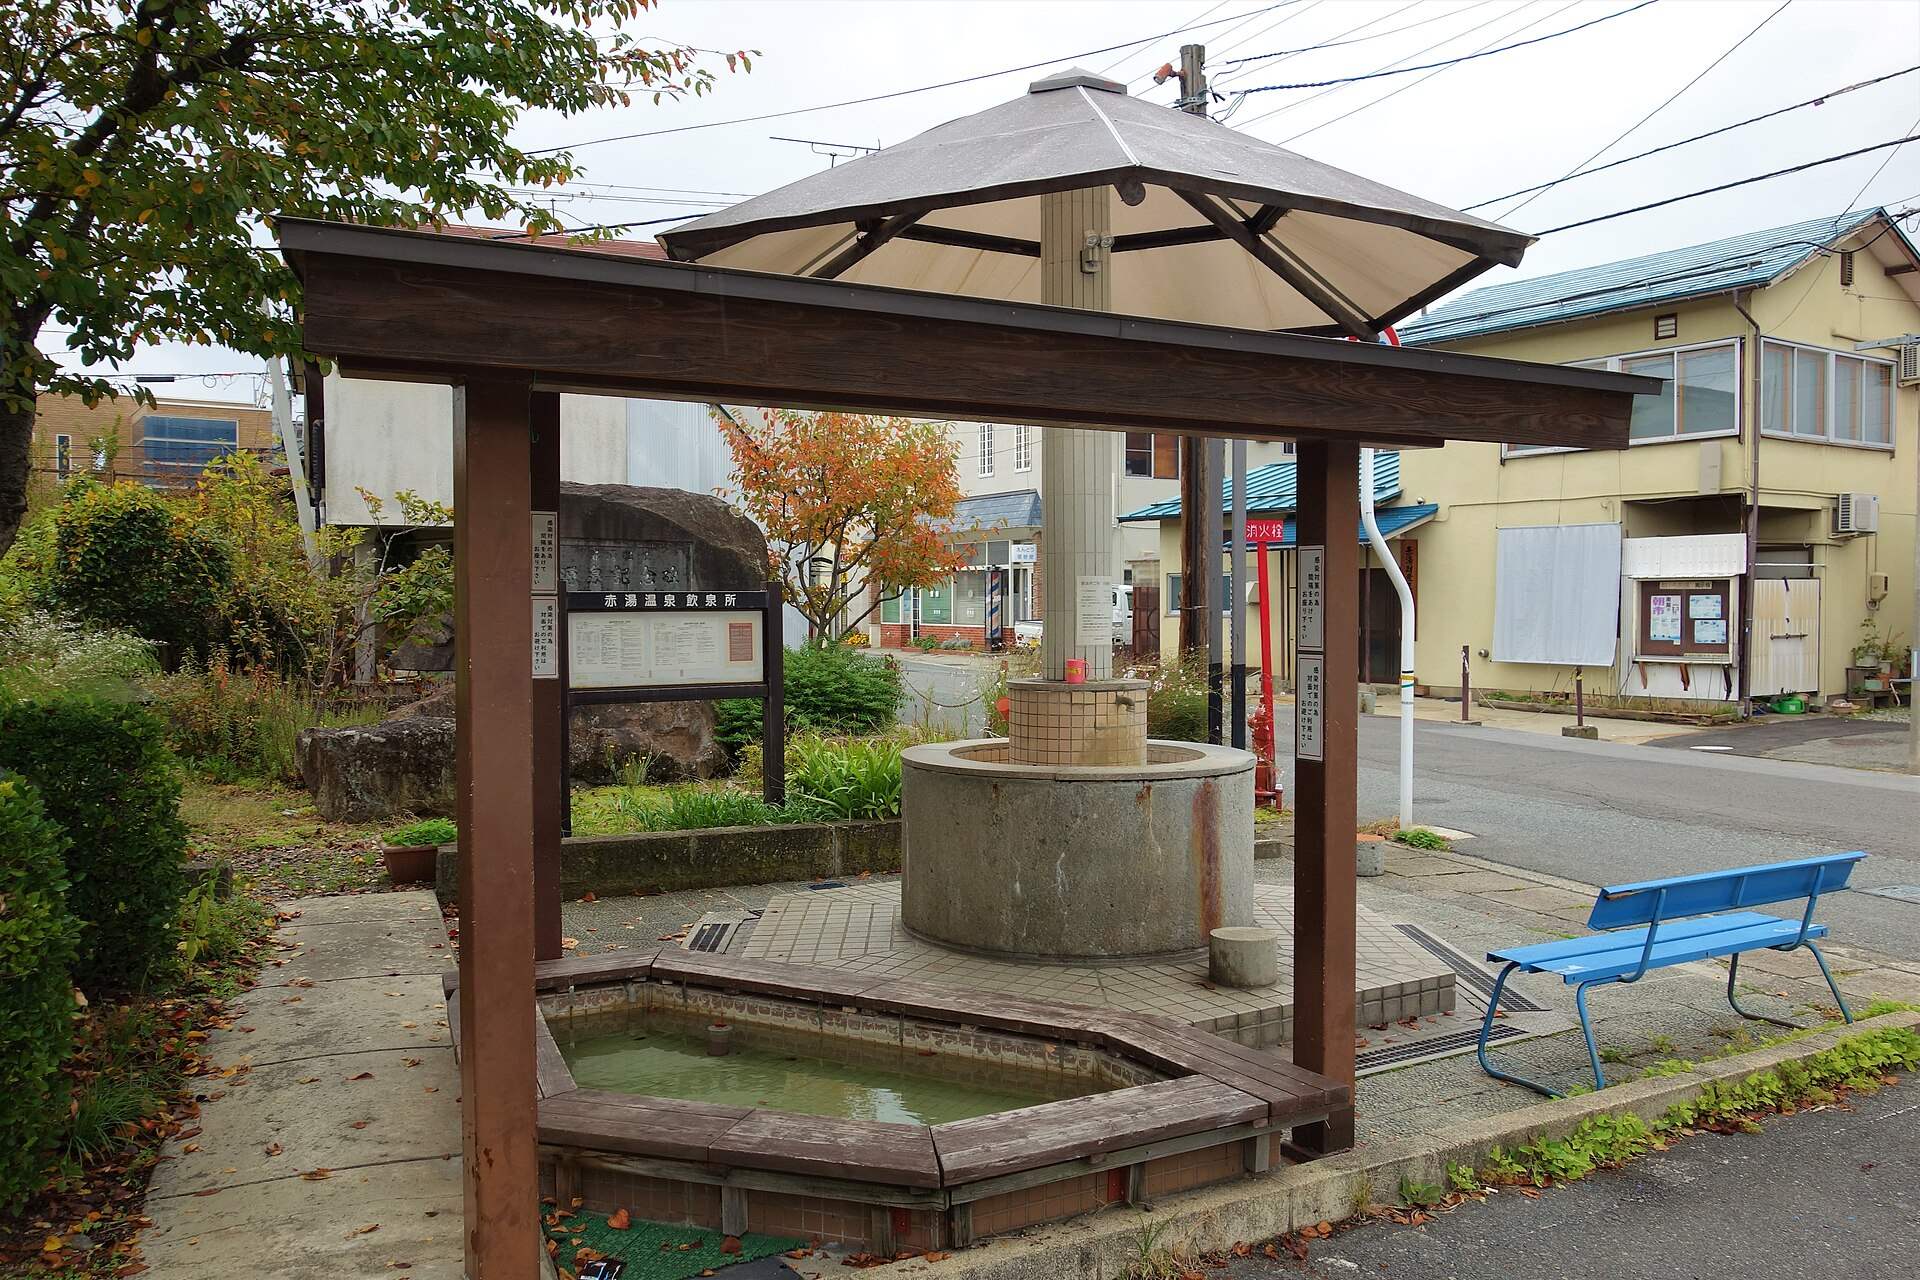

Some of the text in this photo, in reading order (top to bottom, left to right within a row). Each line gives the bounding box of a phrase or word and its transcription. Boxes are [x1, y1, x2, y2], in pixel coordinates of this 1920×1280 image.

[1246, 524, 1283, 538] 消火栓
[604, 593, 737, 608] 赤湯温泉飲泉所
